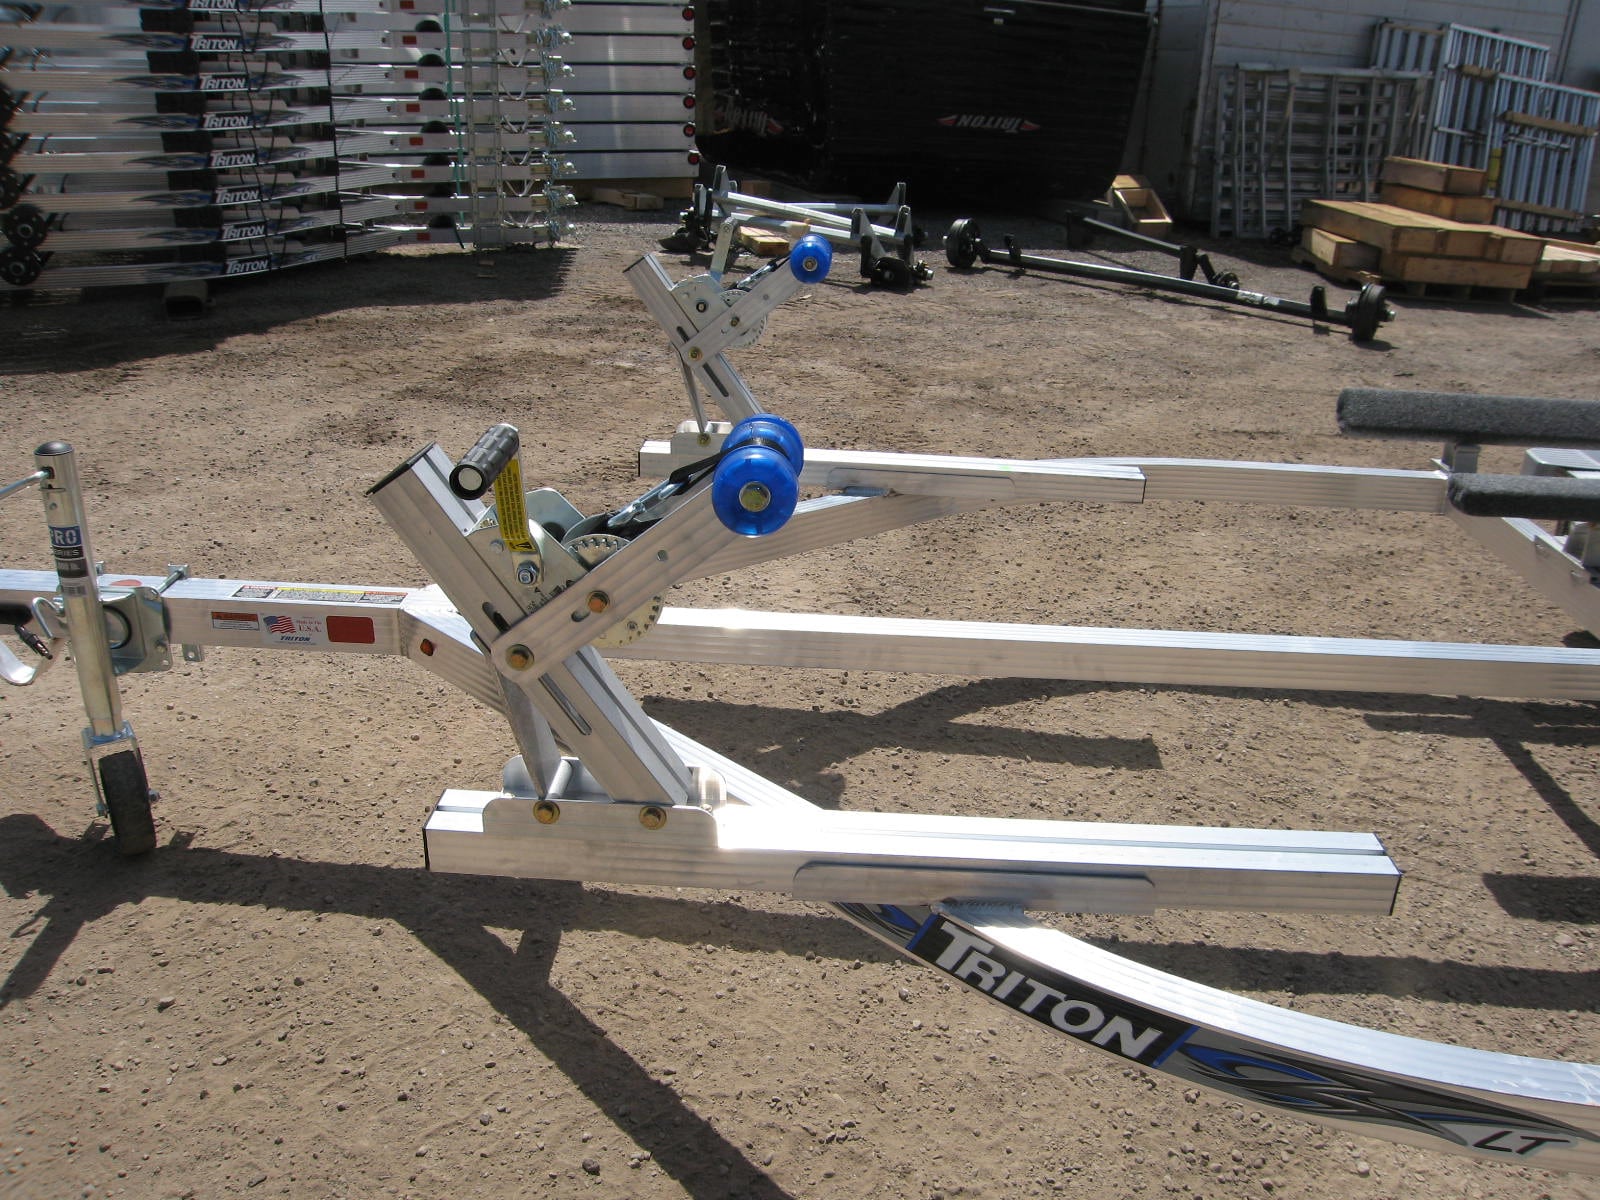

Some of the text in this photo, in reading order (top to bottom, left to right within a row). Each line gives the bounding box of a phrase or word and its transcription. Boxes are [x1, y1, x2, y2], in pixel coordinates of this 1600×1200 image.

[190, 34, 239, 50] TRITON
[199, 76, 246, 90] TRITON
[203, 114, 249, 128] TRITON
[957, 114, 1023, 134] TRITON
[210, 152, 256, 167] TRITON
[215, 189, 260, 204] TRITON
[222, 224, 265, 239] TRITON
[226, 260, 269, 274] TRITON
[935, 921, 1163, 1059] TRITON
[1472, 1130, 1570, 1155] LT
